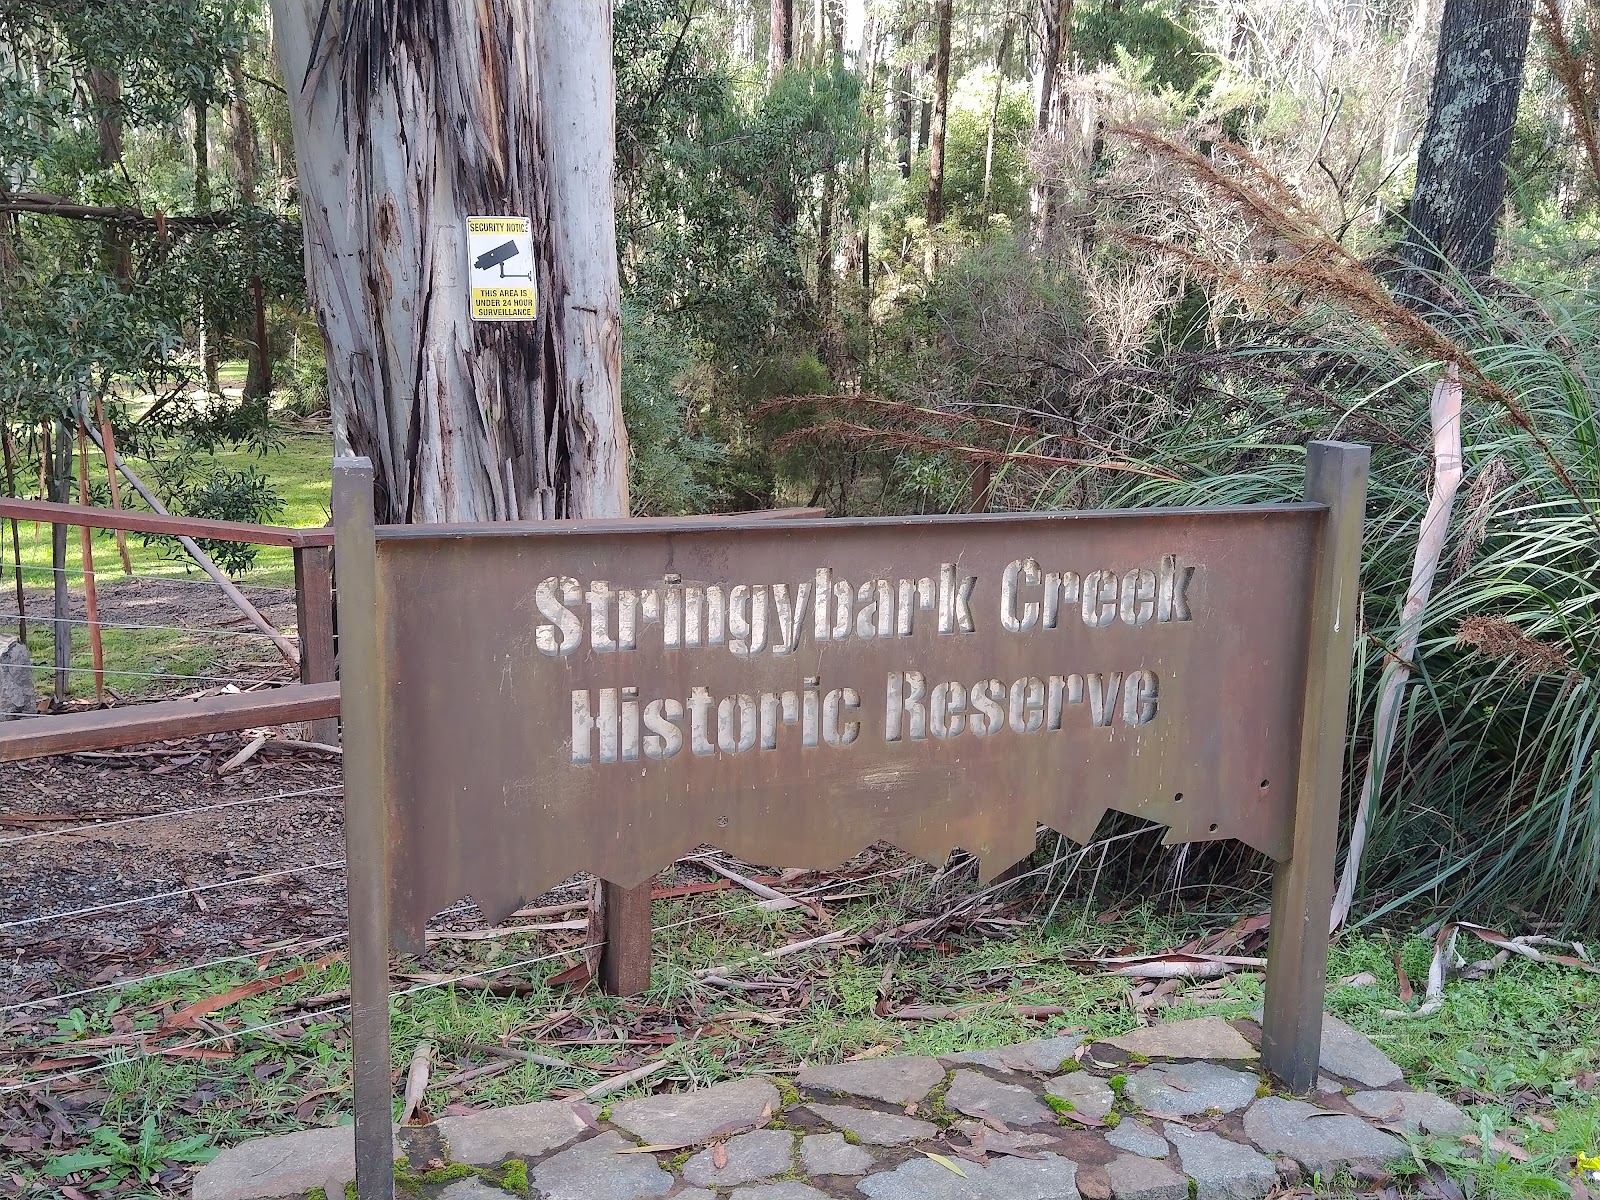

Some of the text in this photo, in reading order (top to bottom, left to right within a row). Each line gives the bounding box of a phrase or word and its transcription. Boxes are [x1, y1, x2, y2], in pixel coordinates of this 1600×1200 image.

[469, 223, 504, 232] SECURITY
[480, 289, 528, 297] THIS AREA IS
[475, 299, 533, 307] UNDER 24 HOUR
[478, 308, 532, 316] SURVEILLANCE
[535, 553, 1195, 658] Stringybark Creek
[570, 669, 1160, 765] Historic Reserve
